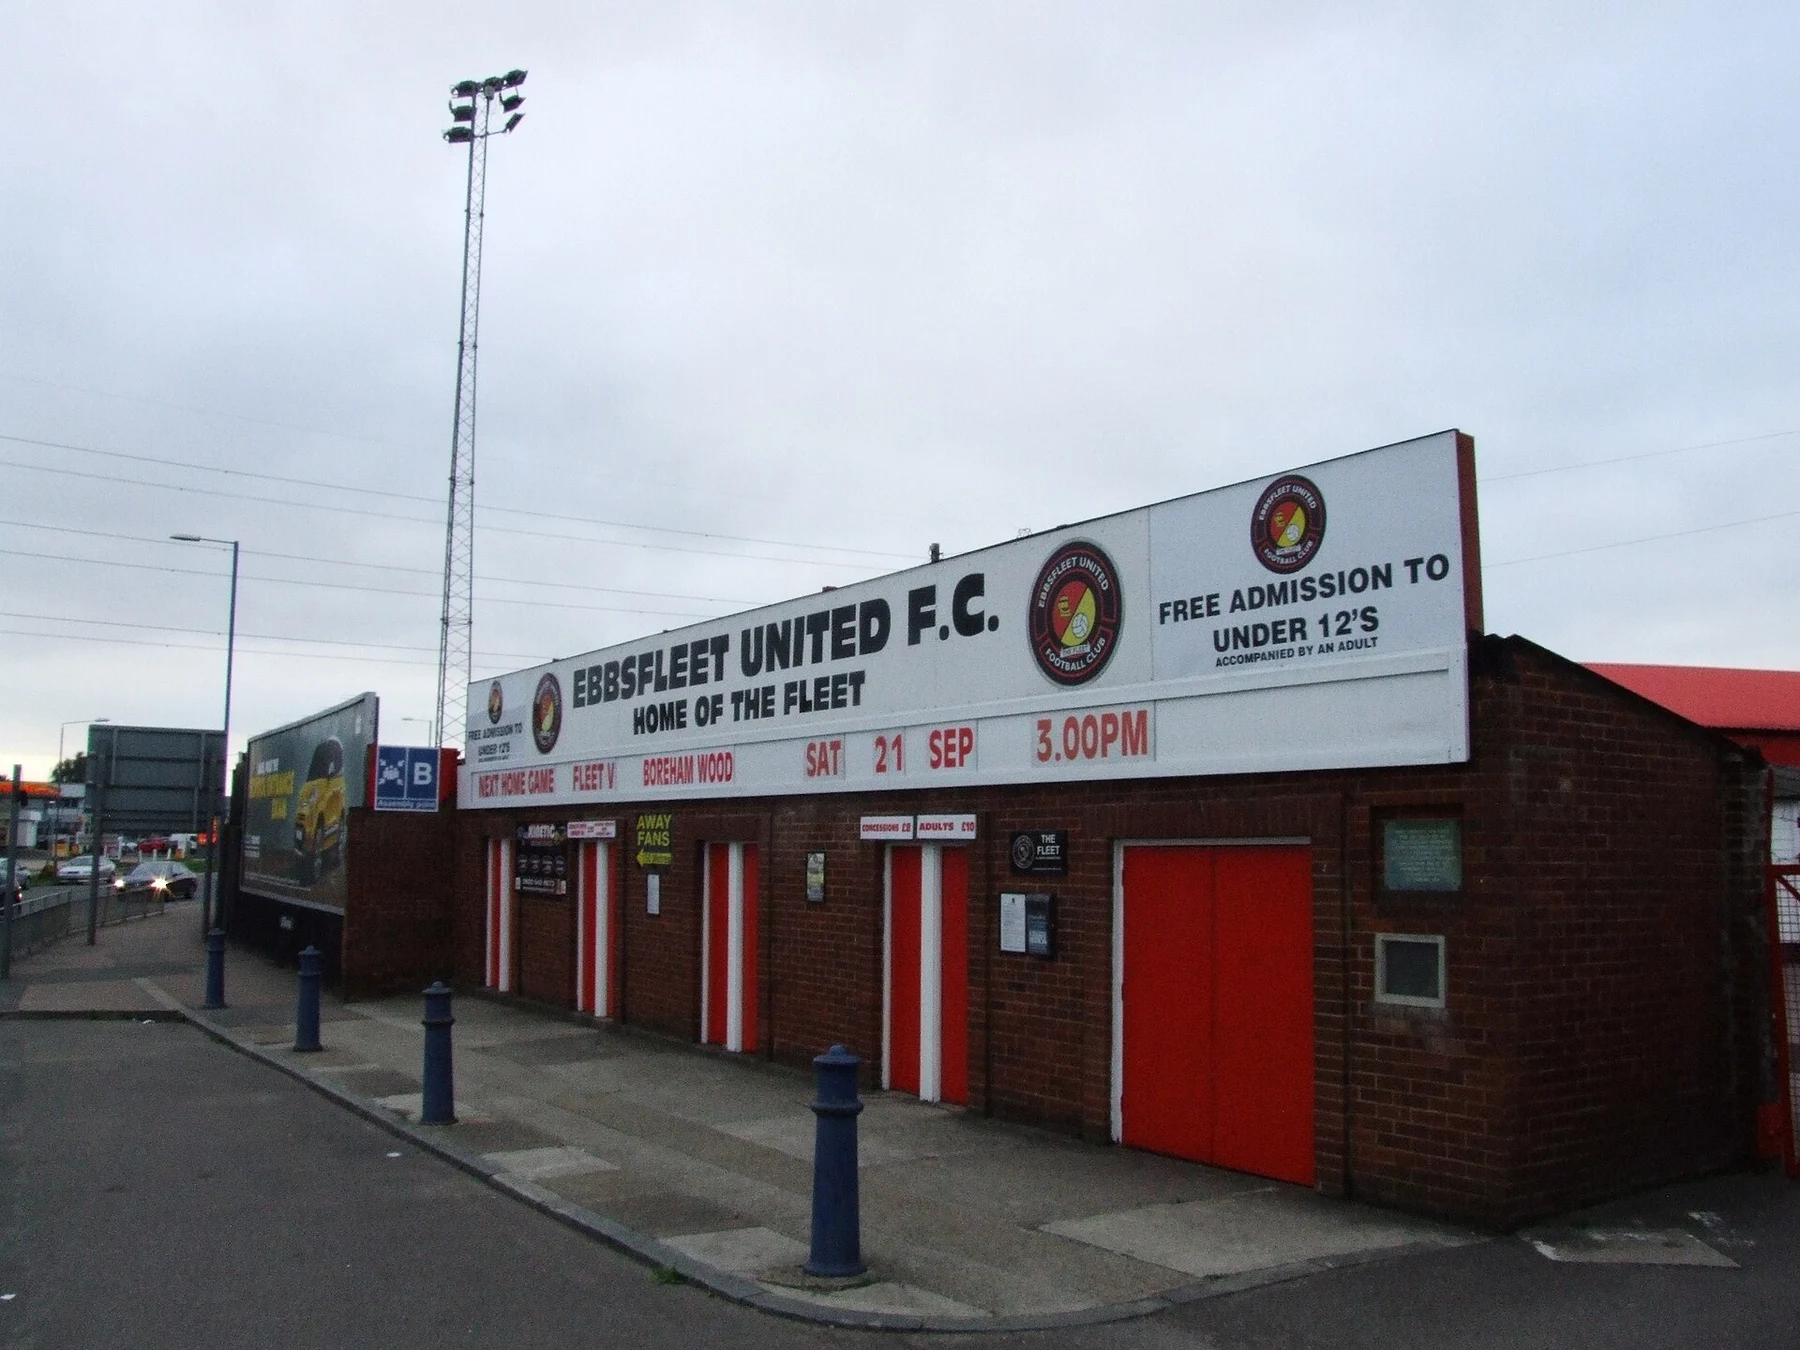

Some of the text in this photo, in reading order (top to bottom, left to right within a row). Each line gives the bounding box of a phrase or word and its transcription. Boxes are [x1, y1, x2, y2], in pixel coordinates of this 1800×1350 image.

[1259, 485, 1317, 520] EBBSFLEET UNITED
[1264, 548, 1297, 564] FOOTBALL
[1297, 540, 1313, 558] CLUB
[1038, 556, 1109, 608] EBBSFLEET UNITED
[1159, 553, 1450, 625] FREE ADMISSION TO
[573, 573, 999, 709] EBBSFLEET UNITED F.C.
[1213, 606, 1380, 653] UNDER 12'S
[1045, 648, 1086, 671] FOOTBALL
[1086, 637, 1106, 663] CLUB
[1215, 636, 1379, 668] ACCOMPANIED BY AN ADULT
[634, 671, 865, 735] HOME OF THE FLEET
[479, 709, 1148, 798] NEXT HOME GAME FLEET V BOREHAM WOOD SAT 21 SEP 3.00PM
[413, 762, 431, 785] B
[637, 814, 672, 829] AWAY
[862, 823, 899, 832] CONCESSIONS
[919, 821, 975, 832] ADULTS £10
[637, 831, 670, 847] FANS
[1036, 845, 1060, 856] FLEET
[1041, 834, 1055, 844] THE
